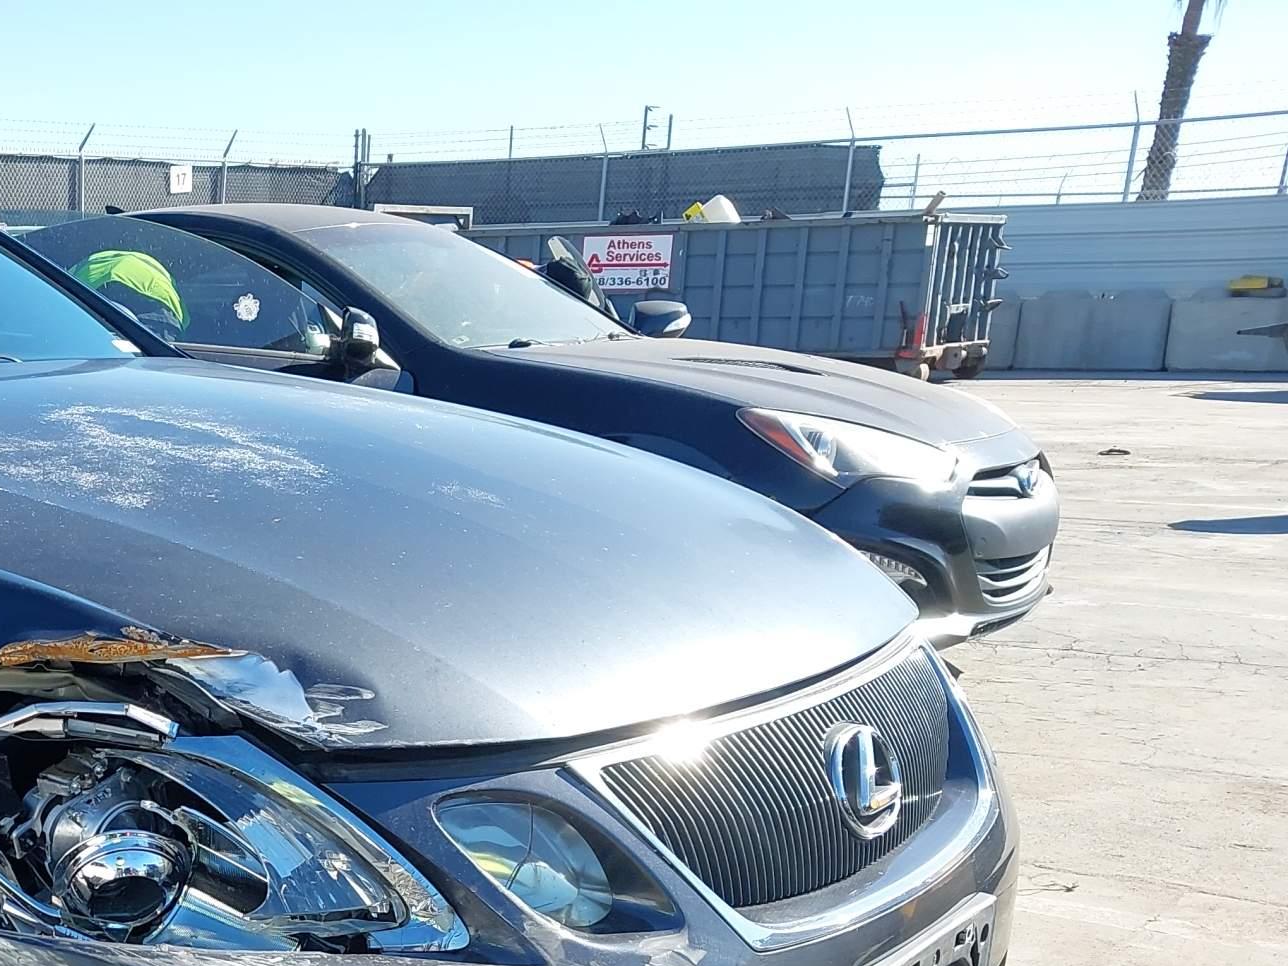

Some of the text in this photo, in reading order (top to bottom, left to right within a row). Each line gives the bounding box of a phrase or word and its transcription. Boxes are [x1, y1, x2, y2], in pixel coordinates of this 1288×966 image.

[175, 172, 187, 186] 17
[608, 239, 653, 250] Athens
[606, 250, 662, 262] Services
[596, 276, 667, 287] 8/336-6100
